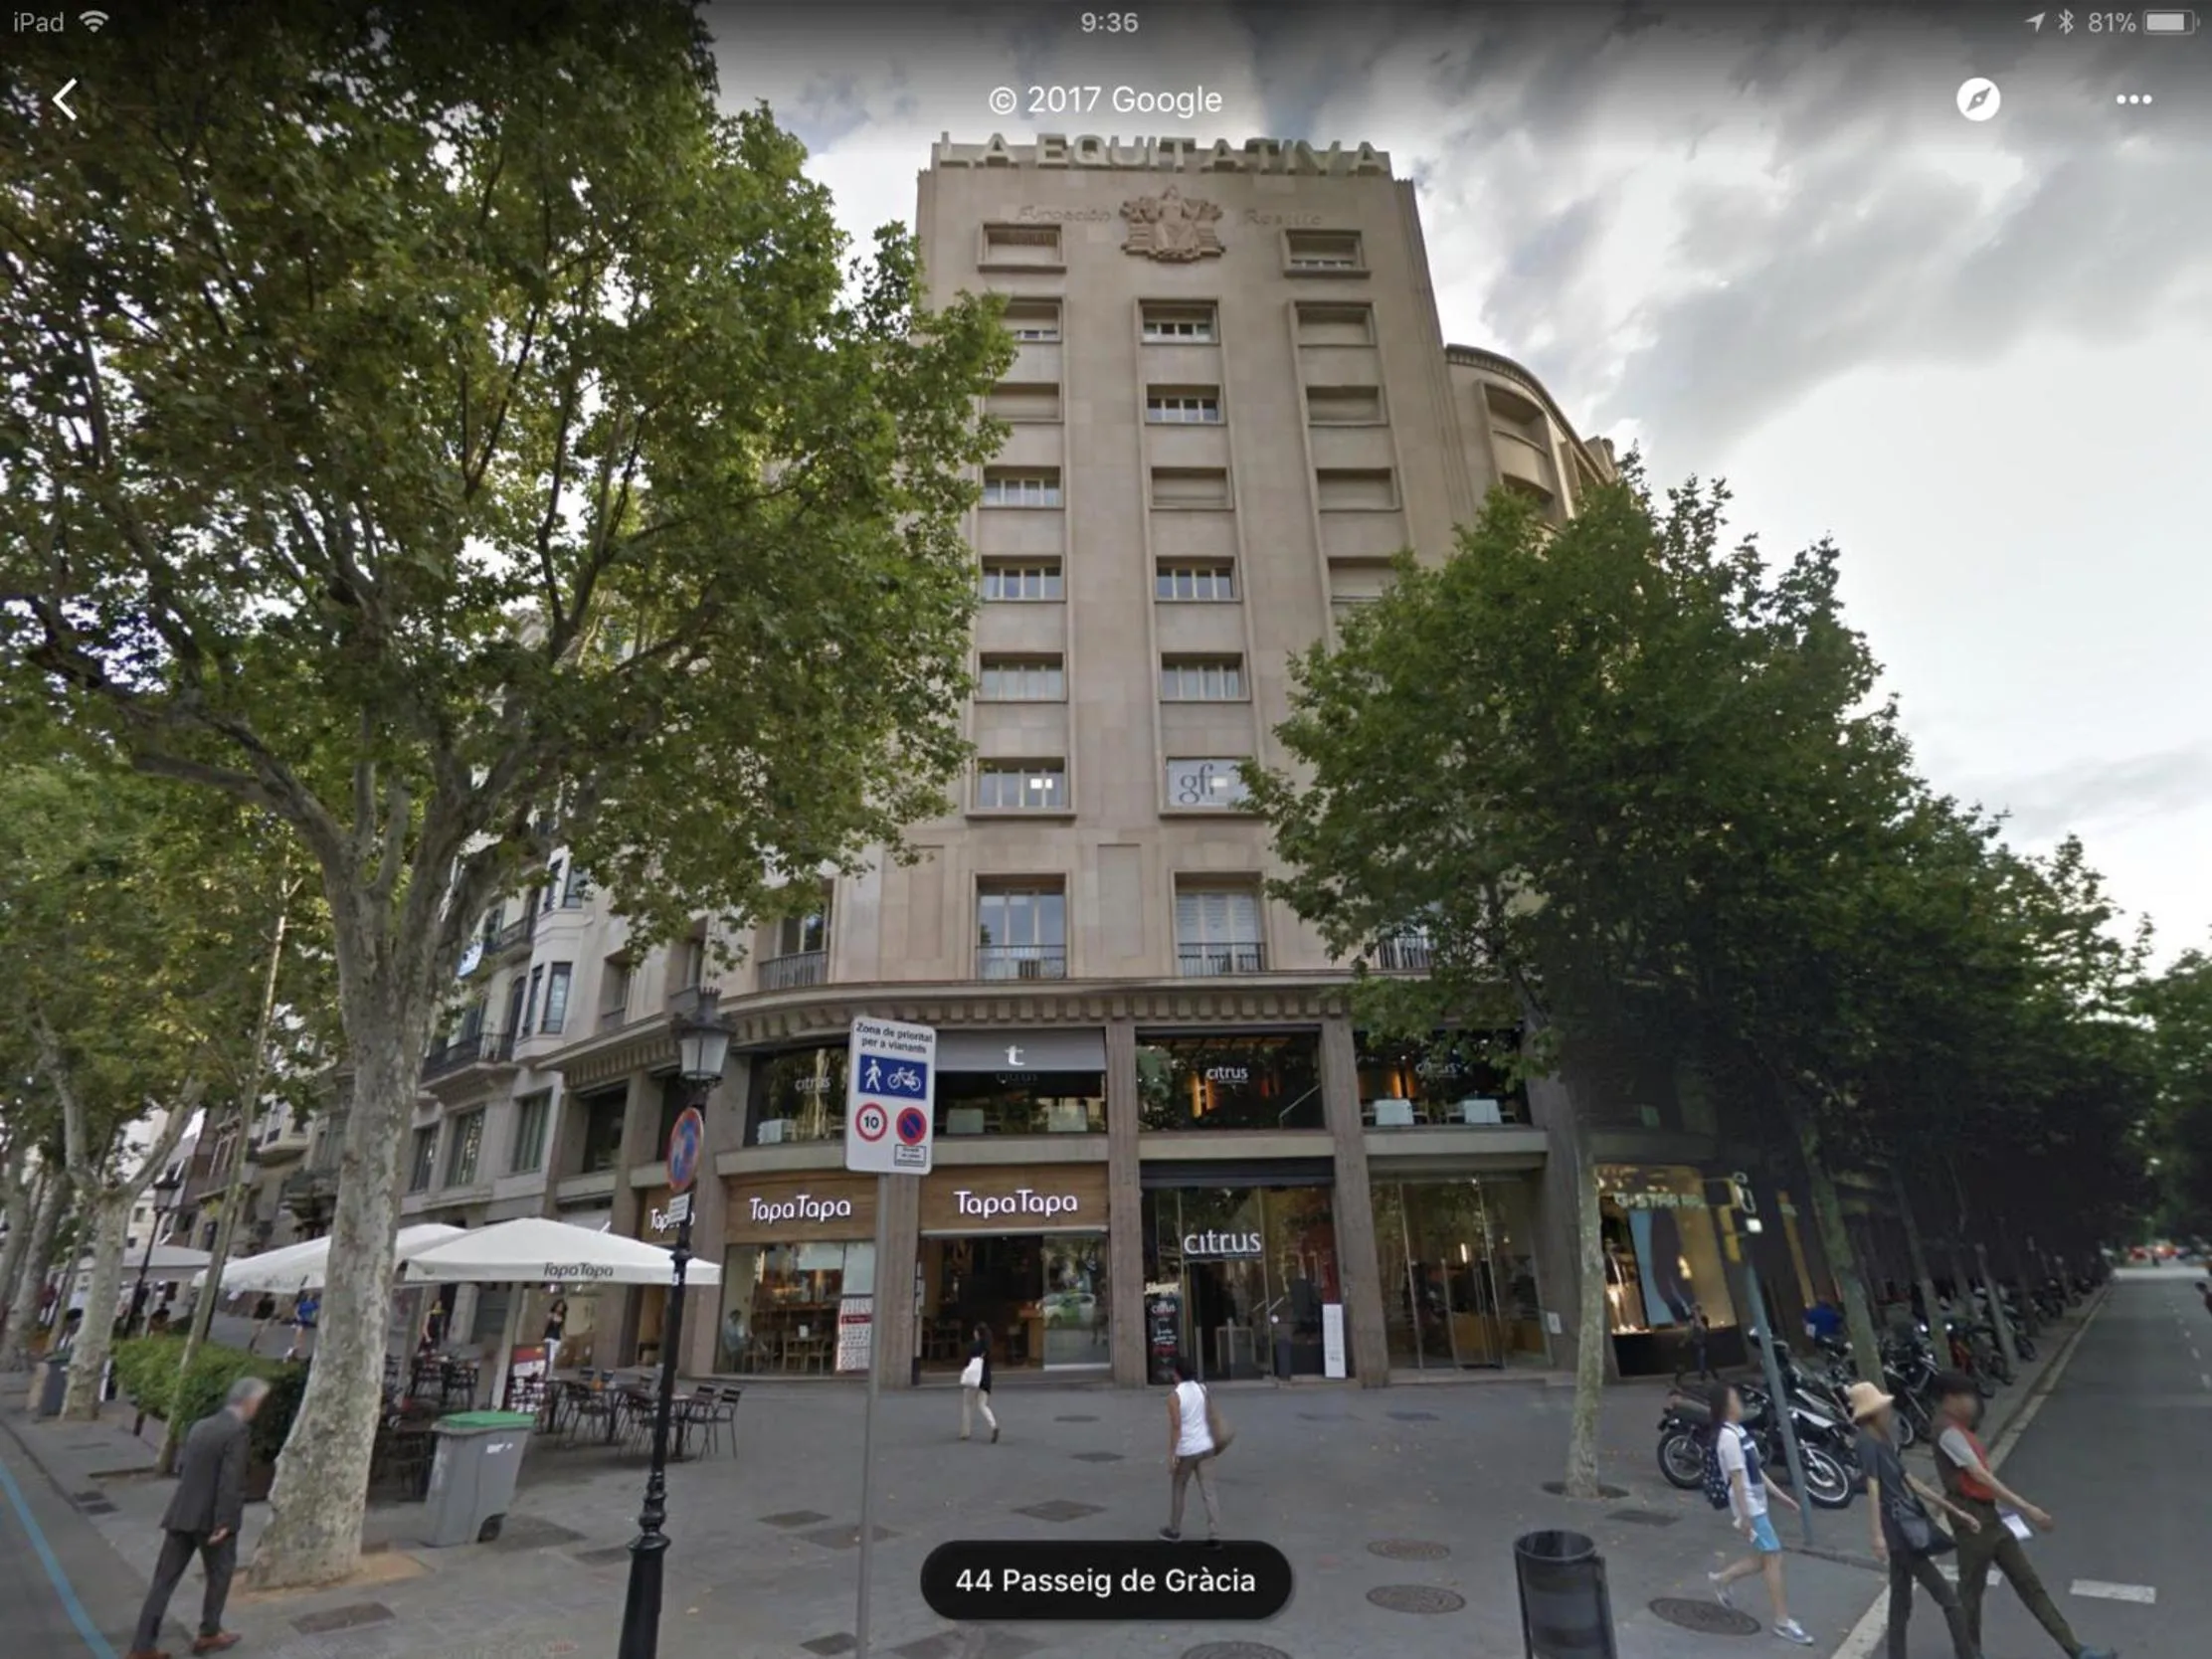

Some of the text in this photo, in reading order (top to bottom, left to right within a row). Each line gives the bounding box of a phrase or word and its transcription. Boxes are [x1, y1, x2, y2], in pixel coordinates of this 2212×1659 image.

[939, 131, 1389, 176] LA EQUITATIVA
[855, 1020, 933, 1043] Zona de prioritat
[861, 1037, 877, 1047] per
[879, 1039, 886, 1049] a
[1205, 1066, 1249, 1080] citrus
[863, 1115, 880, 1130] 10
[749, 1194, 851, 1224] TapaTapa
[953, 1189, 1079, 1218] TapaTapa
[1184, 1229, 1261, 1254] citrus
[544, 1261, 615, 1279] TapaTapa
